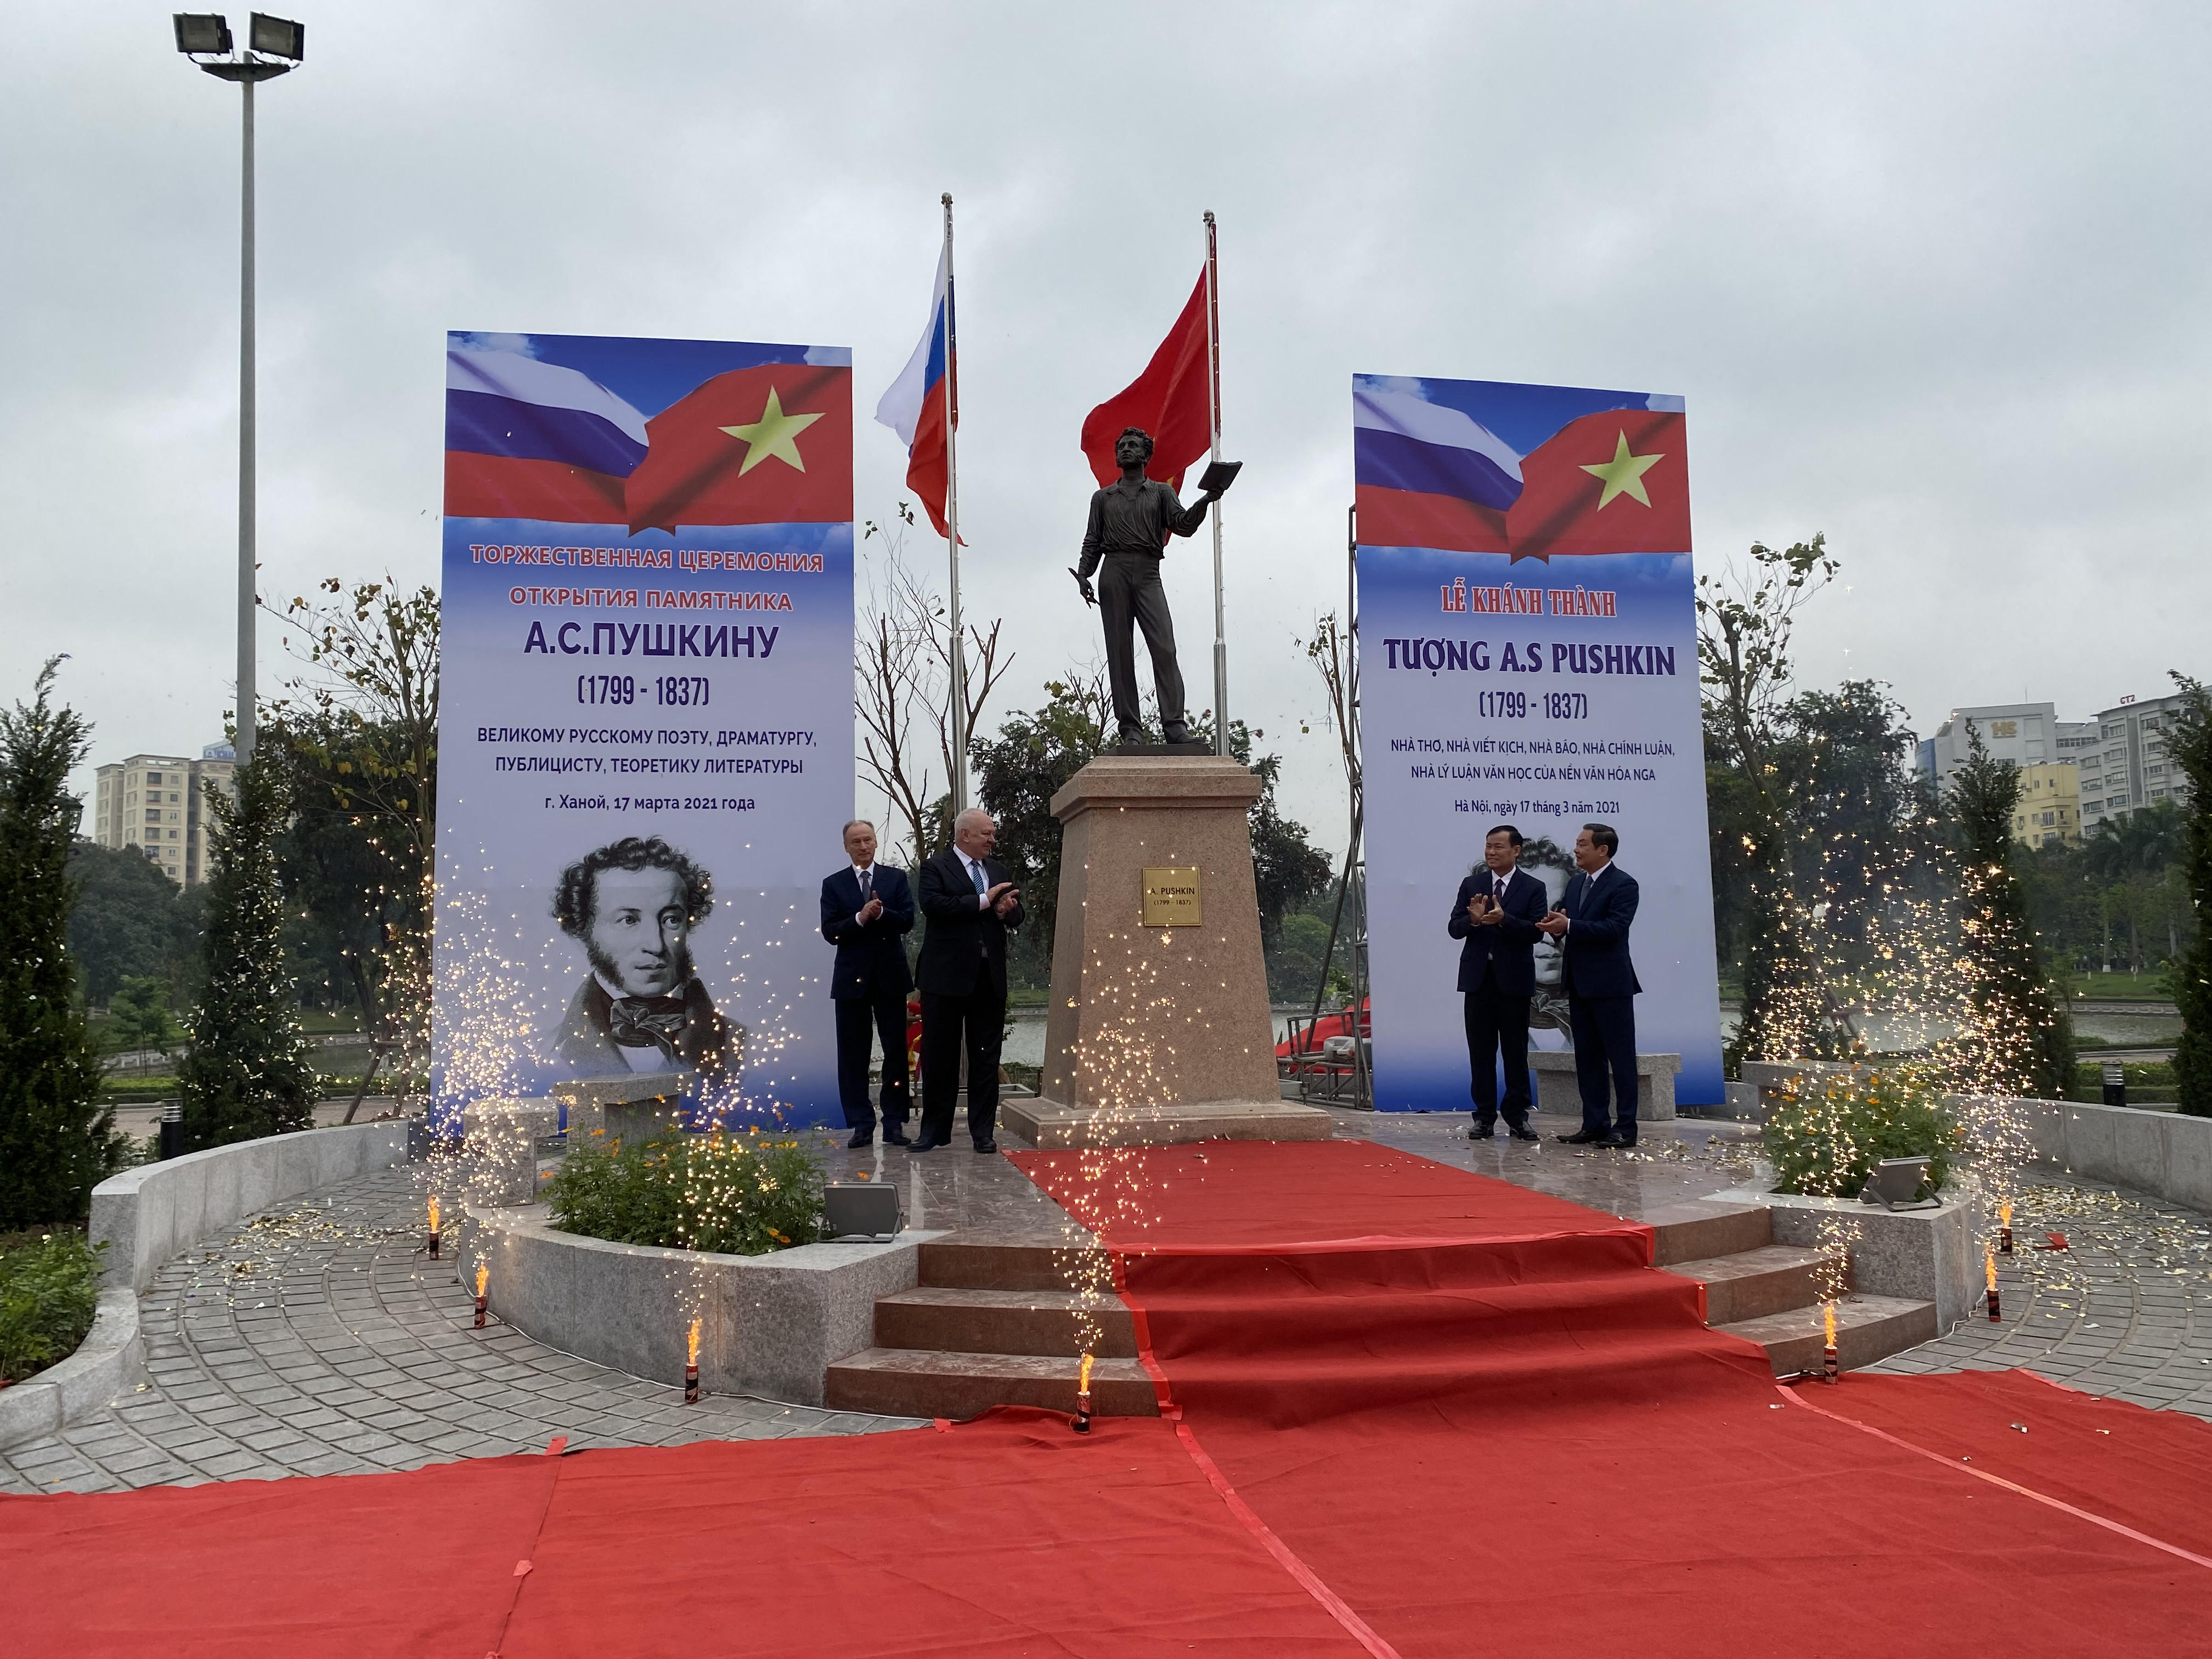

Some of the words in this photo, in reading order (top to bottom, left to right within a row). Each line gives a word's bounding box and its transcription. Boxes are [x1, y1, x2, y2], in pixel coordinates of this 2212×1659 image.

[471, 545, 672, 567] ТОРЖЕСТВЕННАЯ
[680, 551, 823, 572] ЦЕРЕМОНИЯ
[510, 588, 637, 606] ОТКРЫТИЯ
[646, 590, 792, 611] ПАМЯТНИКА
[1442, 577, 1466, 612] LỄ
[1472, 582, 1542, 614] KHÁNH
[1549, 584, 1616, 617] THÀNH
[523, 621, 780, 658] А.С.ПУШКИНУ
[1383, 637, 1490, 677] TƯỢNG
[1499, 642, 1543, 673] A.S
[1551, 643, 1676, 676] PUSHKIN
[578, 675, 634, 705] (1799
[656, 676, 709, 706] 1837)
[1479, 691, 1526, 718] (1799
[1543, 692, 1587, 719] 1837)
[478, 727, 565, 743] ВЕЛИКОМУ
[569, 729, 653, 744] РУССКОМУ
[658, 730, 712, 747] ПОЭТУ,
[716, 731, 816, 747] ДРАМАТУРГУ,
[1391, 736, 1415, 752] NHÀ
[1417, 738, 1444, 754] THƠ,
[1447, 737, 1470, 753] NHÀ
[1472, 736, 1496, 753] VIẾT
[1499, 741, 1527, 756] KỊCH,
[1530, 738, 1553, 754] NHÀ
[1555, 739, 1580, 755] BÁO,
[1583, 740, 1606, 754] NHÀ
[1608, 740, 1642, 755] CHÍNH
[1645, 740, 1675, 759] LUẬN,
[496, 757, 606, 774] ПУБЛИЦИСТУ,
[610, 758, 700, 773] ТЕОРЕТИКУ
[704, 759, 803, 774] ЛИТЕРАТУРЫ
[1411, 763, 1435, 778] NHÀ
[1438, 763, 1449, 778] LÝ
[1452, 763, 1480, 781] LUẬN
[1483, 764, 1505, 779] VĂN
[1508, 767, 1532, 782] HỌC
[1534, 764, 1557, 780] CỦA
[1559, 762, 1581, 780] NỀN
[1583, 765, 1605, 780] VĂN
[1607, 765, 1632, 781] HÓA
[1633, 769, 1656, 781] NGA
[545, 798, 555, 809] г.
[559, 794, 609, 811] Ханой,
[614, 797, 630, 811] 17
[634, 798, 680, 813] марта
[684, 797, 718, 809] 2021
[722, 799, 755, 812] года
[1455, 799, 1469, 812] Hà
[1471, 799, 1491, 815] Nội,
[1494, 799, 1517, 816] ngày
[1520, 800, 1530, 812] 17
[1533, 800, 1561, 817] tháng
[1563, 800, 1569, 813] 3
[1572, 800, 1593, 813] năm
[1595, 801, 1620, 813] 2021
